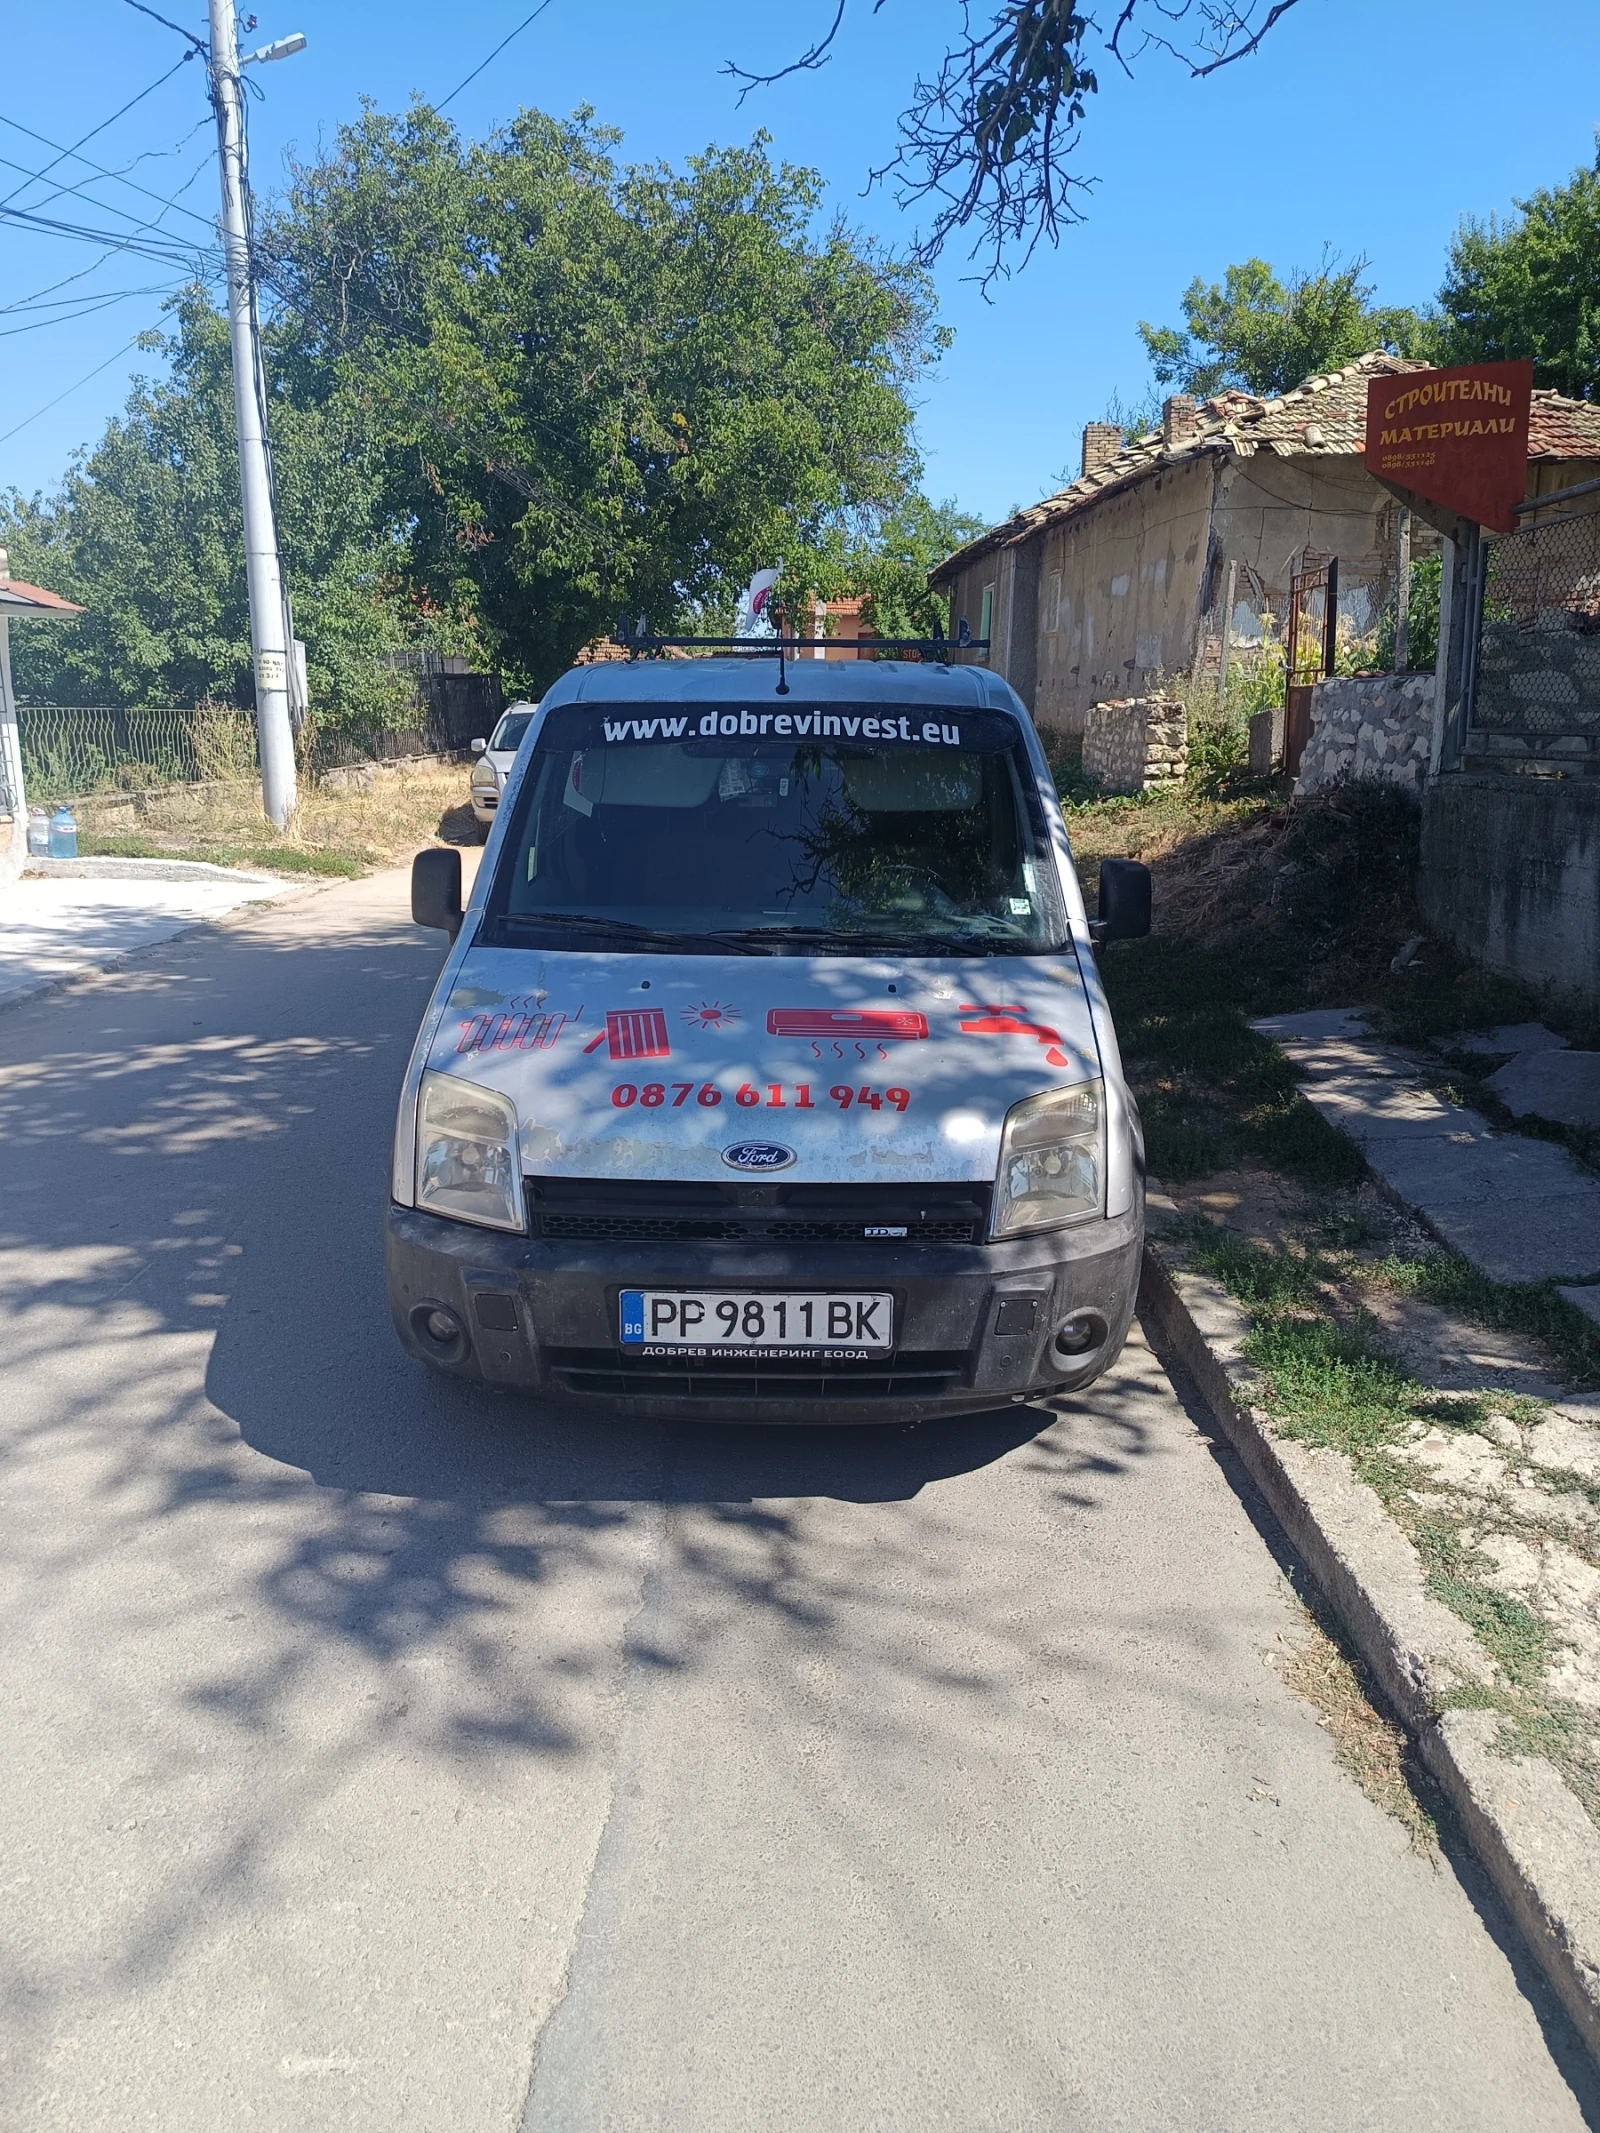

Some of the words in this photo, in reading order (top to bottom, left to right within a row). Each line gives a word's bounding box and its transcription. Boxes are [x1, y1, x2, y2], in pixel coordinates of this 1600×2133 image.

[1384, 379, 1512, 420] СТРОИТЕЛНИ
[1379, 417, 1515, 445] МАТЕРИАЛИ
[1381, 452, 1436, 461] 0898/551125
[603, 711, 960, 744] www.dobrevinvest.eu
[611, 1083, 722, 1108] 0876
[735, 1083, 816, 1108] 611
[829, 1085, 911, 1112] 949
[738, 1146, 779, 1163] Ford
[624, 1323, 642, 1335] BG
[715, 1300, 813, 1339] 9811
[642, 1346, 707, 1356] ДОБРЕВ
[711, 1348, 820, 1358] ИНЖЕНЕРИНГ
[824, 1350, 869, 1359] ЕООД
